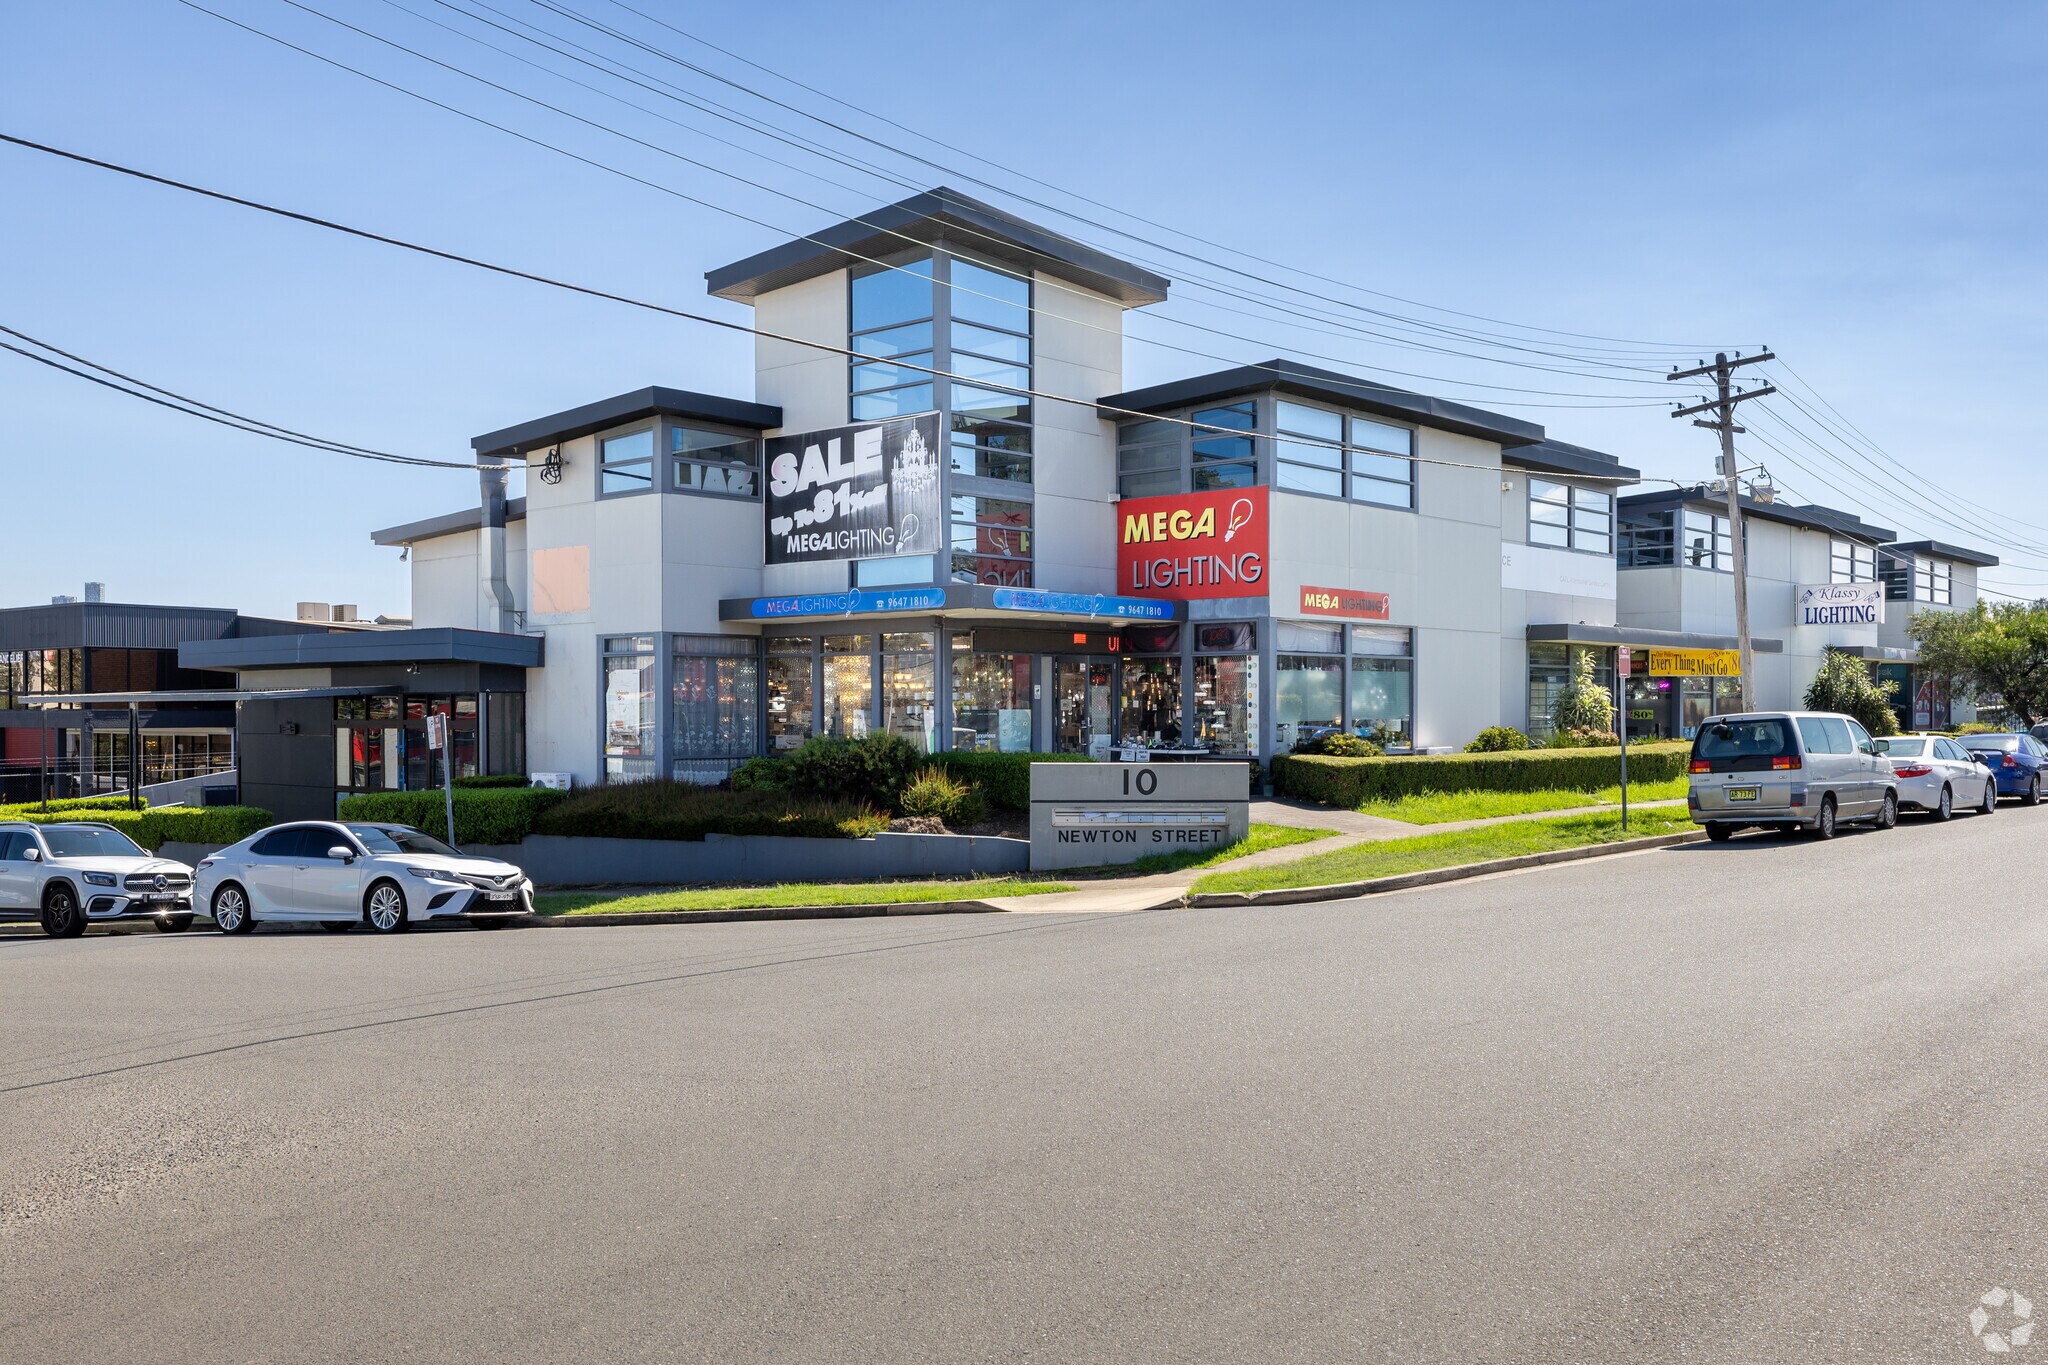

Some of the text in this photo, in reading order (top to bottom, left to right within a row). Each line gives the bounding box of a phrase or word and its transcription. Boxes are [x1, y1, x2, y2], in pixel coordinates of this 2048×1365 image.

[770, 426, 883, 498] SALE
[1124, 507, 1216, 544] MEGA
[1133, 552, 1263, 589] LIGHTING
[888, 597, 907, 607] 9647
[910, 595, 929, 606] 1810
[1304, 593, 1383, 613] MEGA LIGHTING
[1819, 586, 1861, 601] Klassy
[1128, 604, 1144, 615] 9647
[1146, 606, 1162, 616] 1810
[1805, 605, 1876, 624] LIGHTING
[1651, 654, 1672, 675] Every
[1674, 654, 1695, 675] Thing
[1697, 659, 1715, 675] Must
[1123, 768, 1158, 796] 10
[1058, 829, 1222, 843] NEWTON STREET
